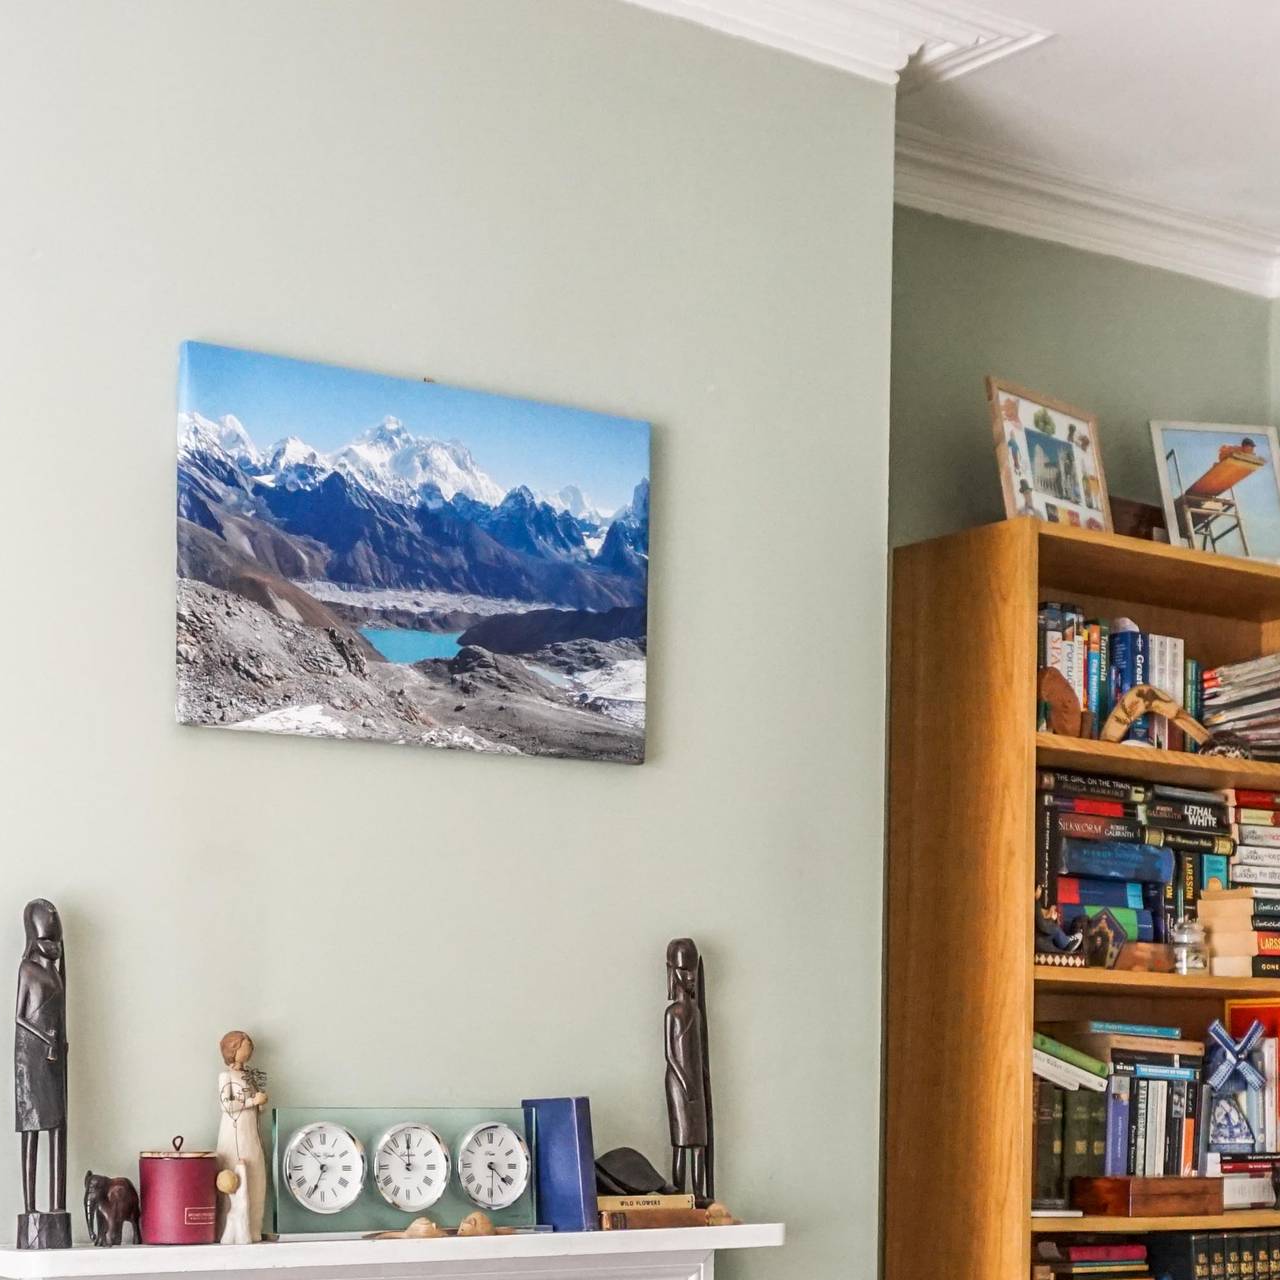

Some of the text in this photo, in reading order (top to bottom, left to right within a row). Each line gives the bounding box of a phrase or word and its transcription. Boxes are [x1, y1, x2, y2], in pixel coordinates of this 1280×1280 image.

[1100, 635, 1109, 682] Tanzania
[1136, 654, 1145, 686] Great
[1056, 773, 1130, 790] THE GIRL ON THE TRAIN
[1184, 804, 1213, 817] LETHAL
[1188, 814, 1217, 828] WHITE
[1185, 857, 1194, 899] LARSSON
